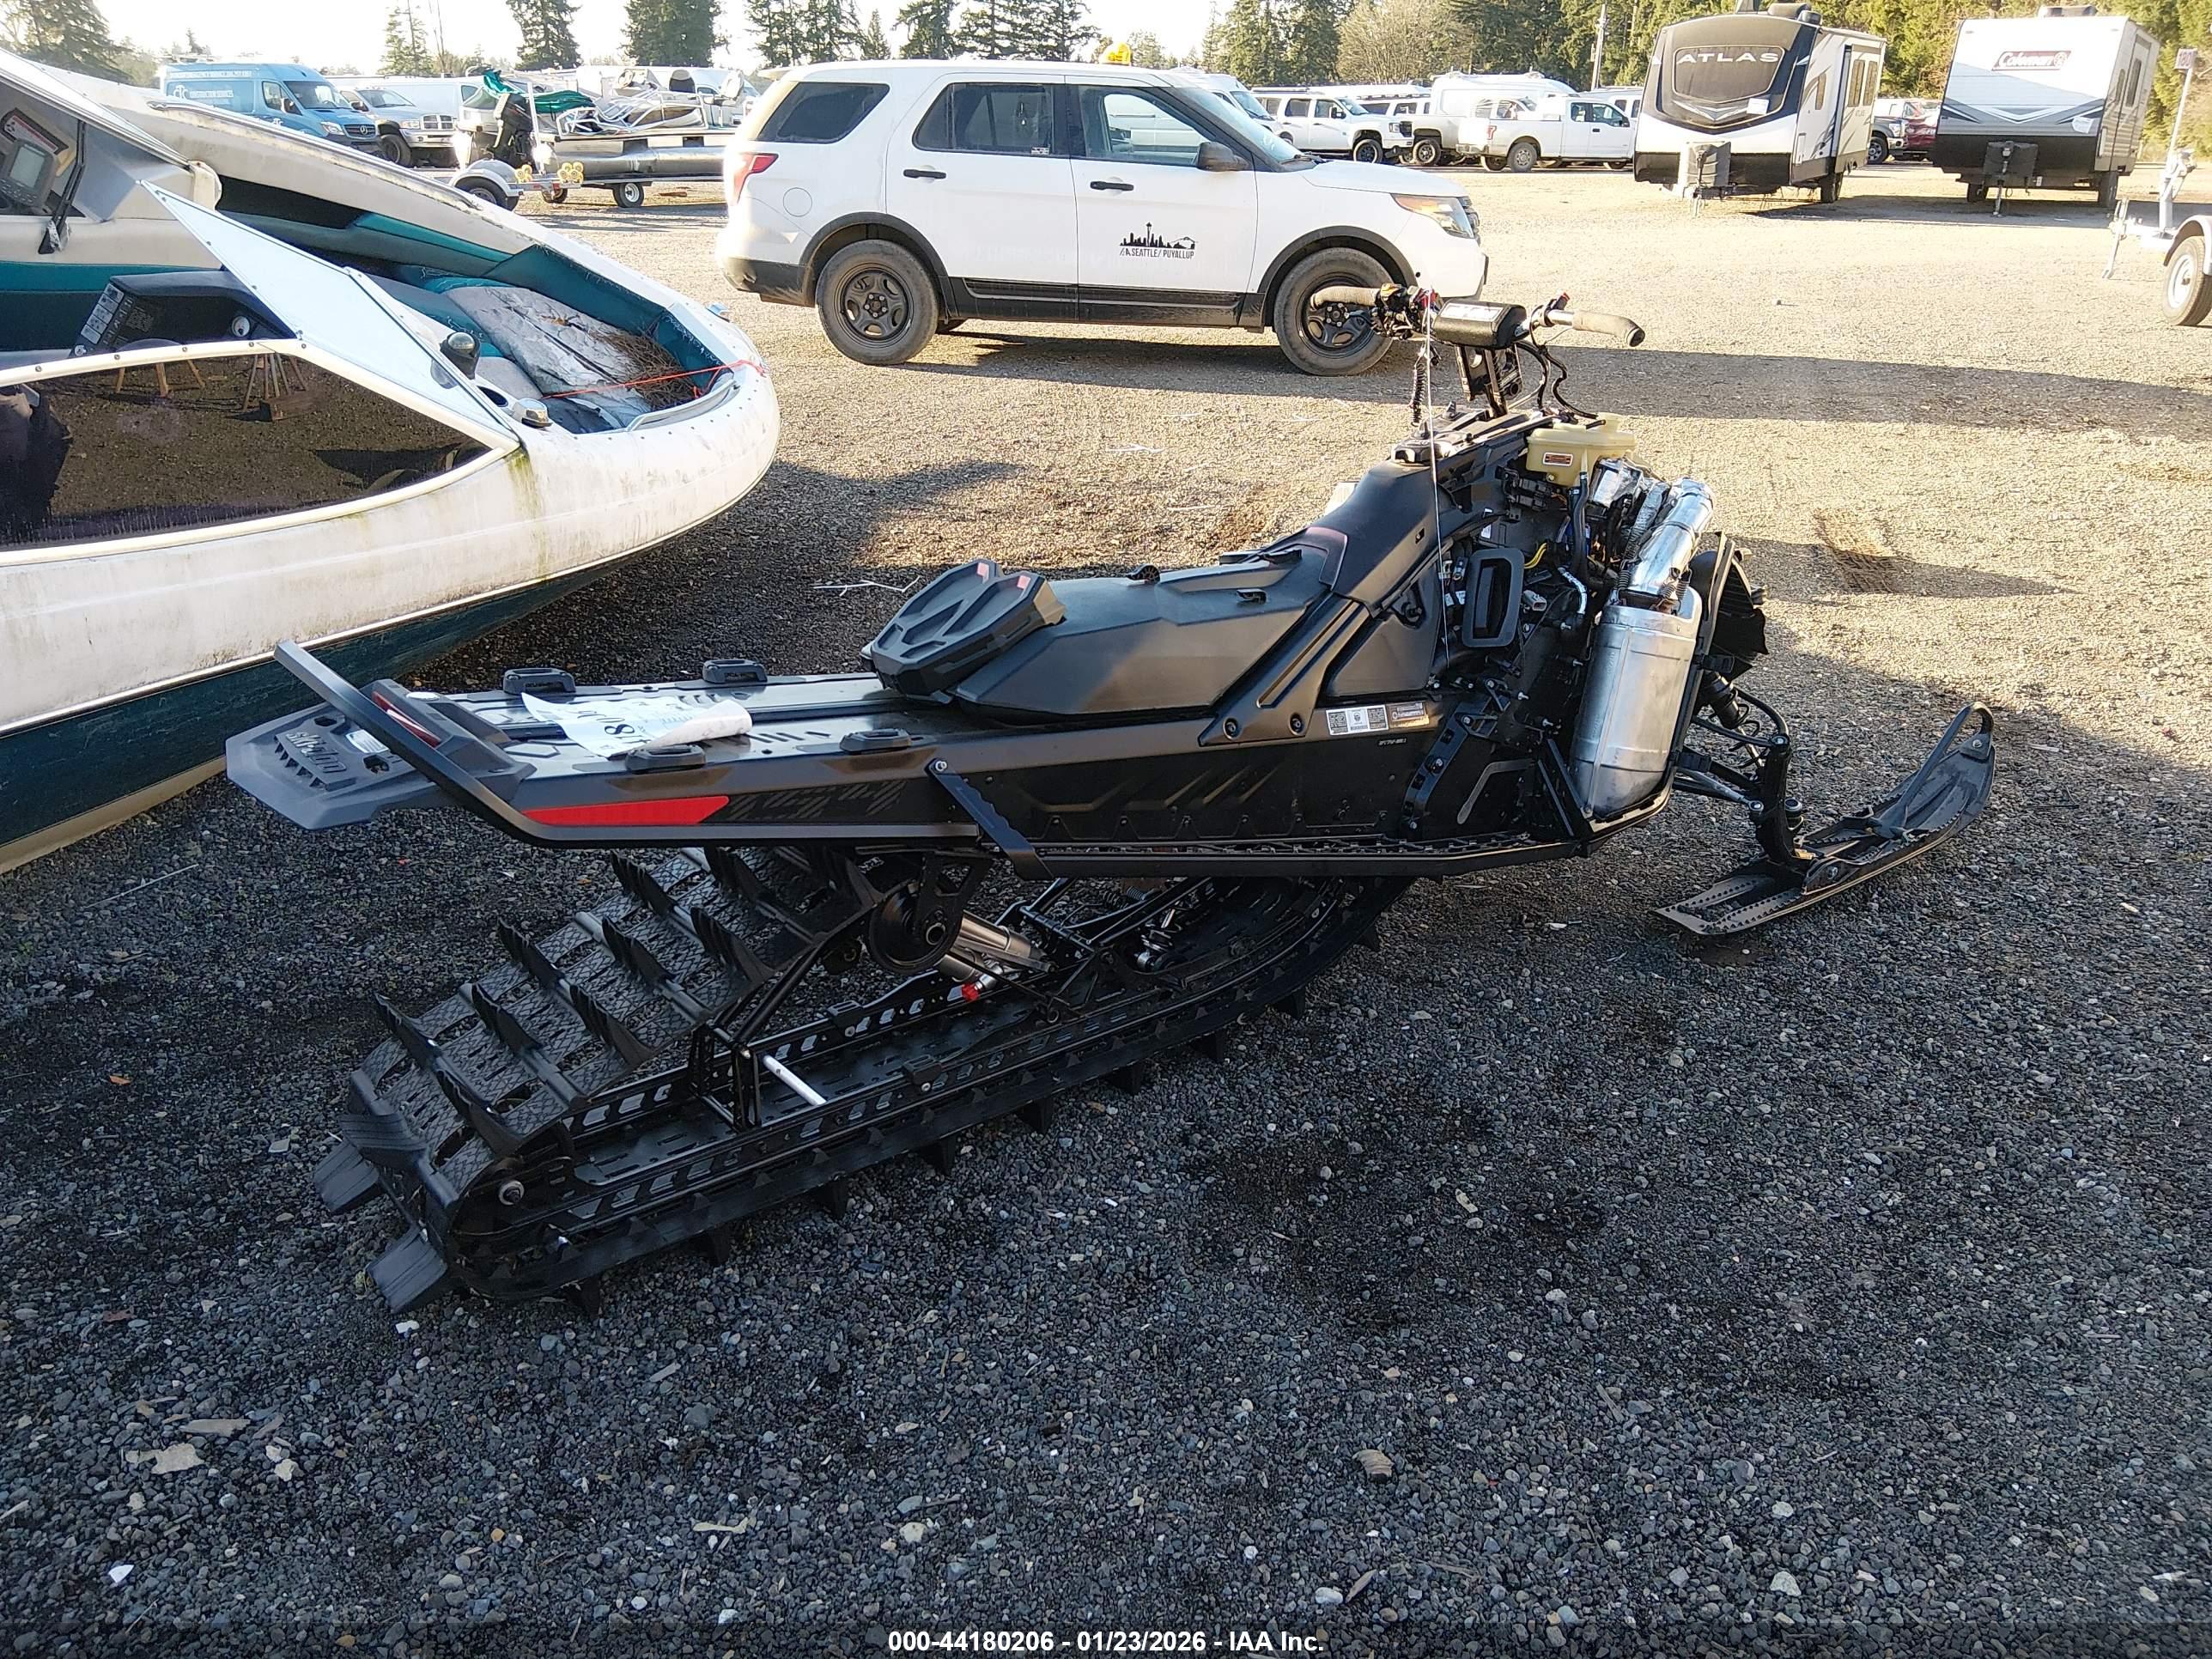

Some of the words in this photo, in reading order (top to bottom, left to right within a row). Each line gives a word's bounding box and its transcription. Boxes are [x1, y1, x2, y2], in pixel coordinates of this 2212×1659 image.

[1677, 52, 1778, 64] ATLAS
[1998, 52, 2056, 68] Coleman
[1163, 249, 1194, 259] PUYALLUP
